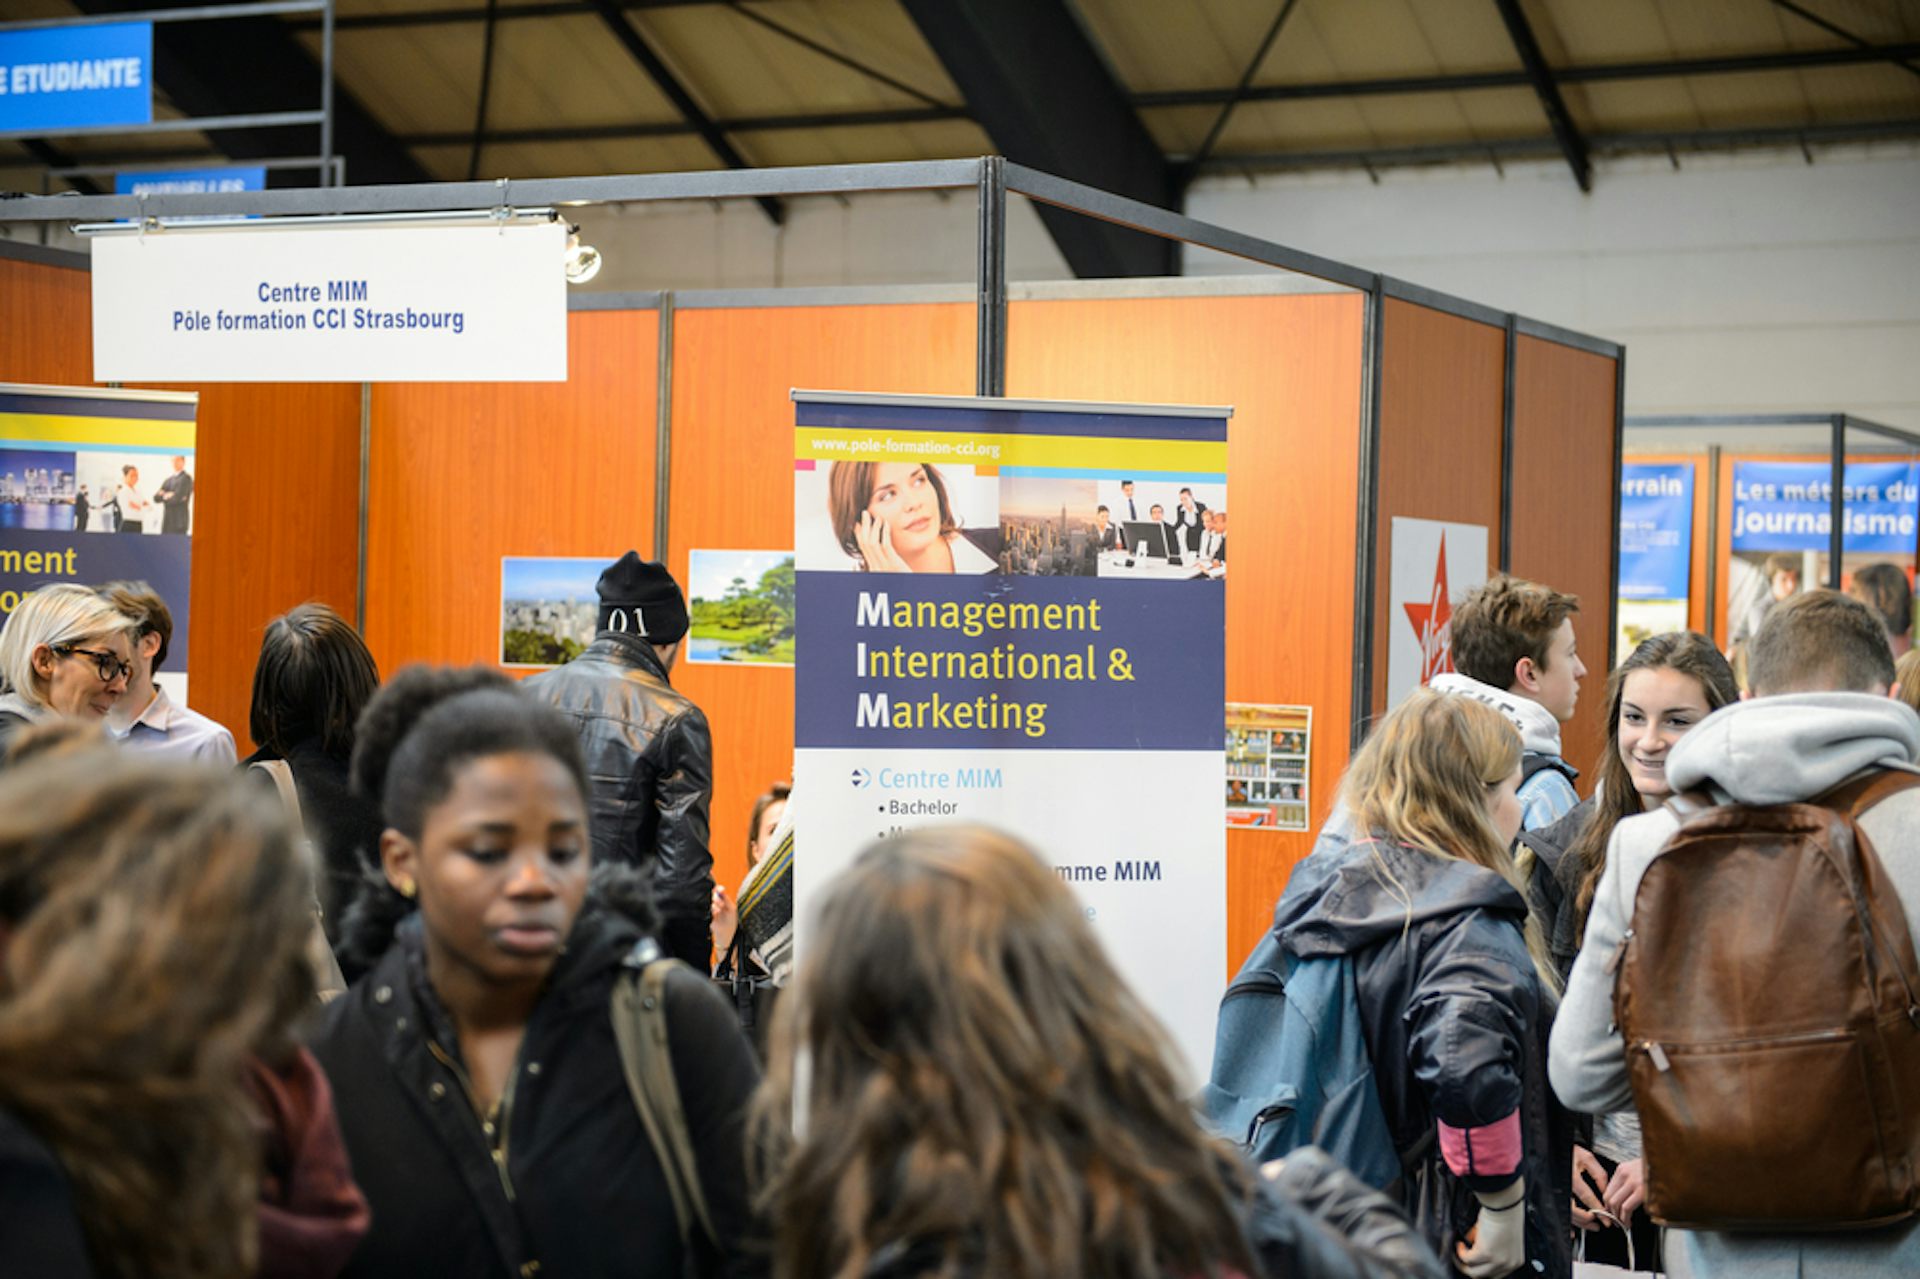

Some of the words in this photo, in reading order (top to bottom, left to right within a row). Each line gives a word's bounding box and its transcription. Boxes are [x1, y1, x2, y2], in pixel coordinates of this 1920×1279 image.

[12, 57, 142, 94] ETUDIANTE
[258, 282, 321, 302] Centre
[328, 280, 369, 301] MIM
[173, 310, 211, 331] Pôle
[217, 309, 306, 331] formation
[312, 308, 346, 329] CCI
[353, 307, 465, 334] Strasbourg
[811, 437, 1001, 458] www.pole-formation-cci.org
[1620, 474, 1684, 497] rrain
[1735, 480, 1777, 501] Les
[1783, 479, 1880, 501] méters
[1885, 480, 1918, 503] du
[1733, 506, 1915, 538] journaisme
[856, 591, 1101, 638] Management
[857, 642, 1097, 680] International
[1106, 648, 1136, 681] &
[856, 692, 1048, 738] Marketing
[878, 767, 950, 788] Centre
[956, 768, 1003, 788] MIM
[889, 799, 958, 815] Bachelor
[1114, 861, 1162, 881] MIM
